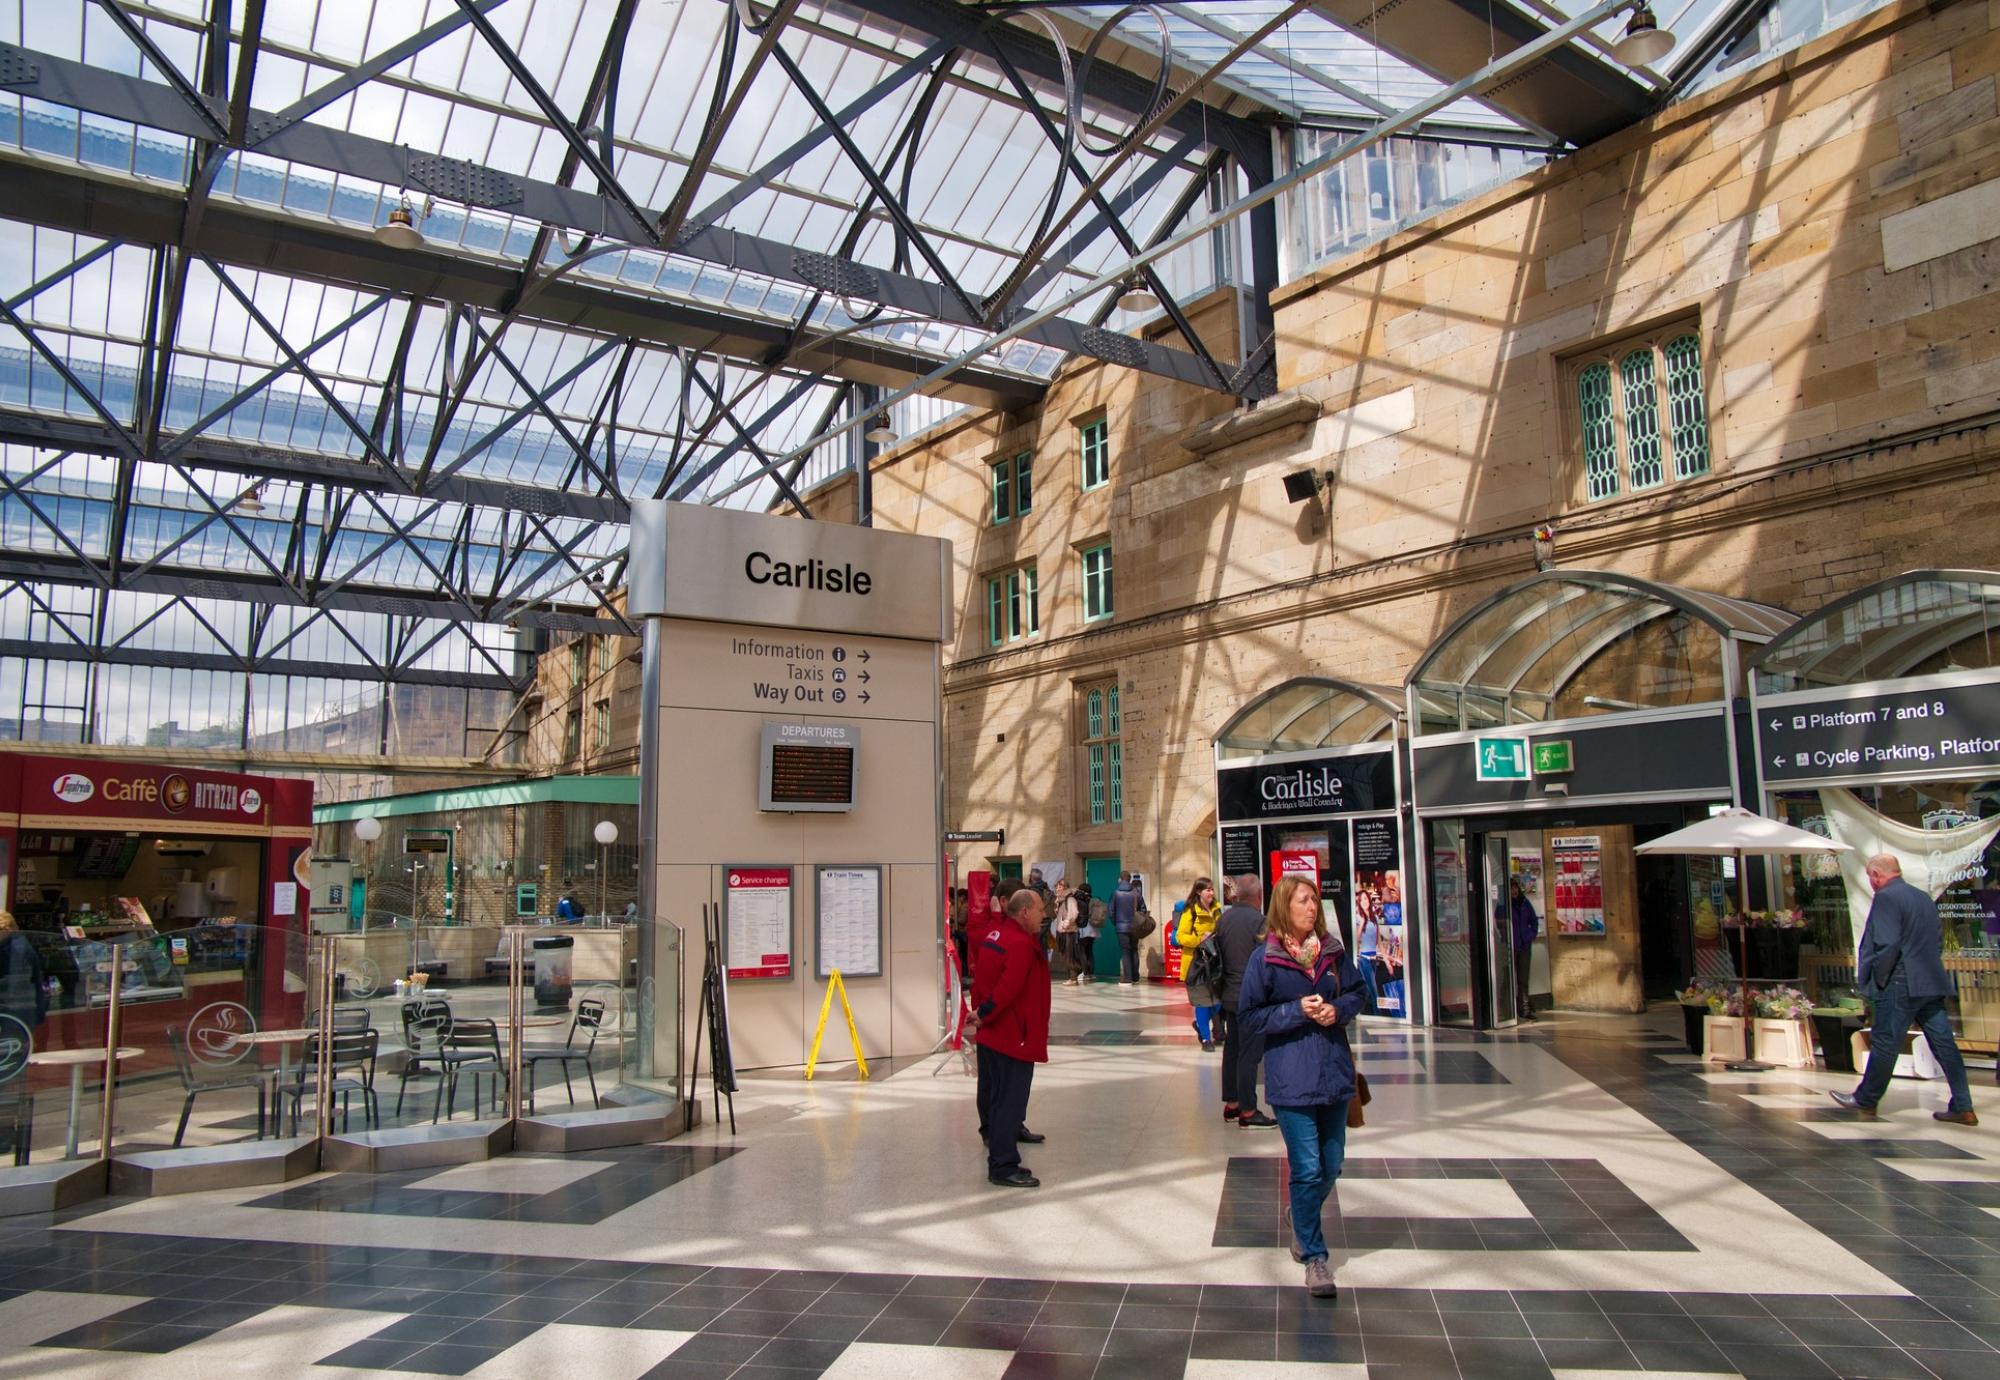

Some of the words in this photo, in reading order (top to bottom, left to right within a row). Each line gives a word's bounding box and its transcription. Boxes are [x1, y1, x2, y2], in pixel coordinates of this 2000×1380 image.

[745, 551, 872, 595] Carlisle
[733, 638, 824, 661] Information
[787, 664, 824, 681] Taxis
[754, 683, 789, 704] Way
[795, 685, 824, 702] Out
[1810, 710, 1876, 728] Platform
[1880, 707, 1891, 721] 7
[1896, 703, 1928, 720] and
[1933, 701, 1944, 716] 8
[782, 726, 845, 738] DEPARTURES
[1814, 749, 1860, 768] Cycle
[1865, 744, 1935, 762] Parking,
[1941, 738, 2000, 755] Platfor
[103, 778, 158, 802] Caffè
[1261, 767, 1342, 800] Carlisle
[741, 876, 763, 885] Service
